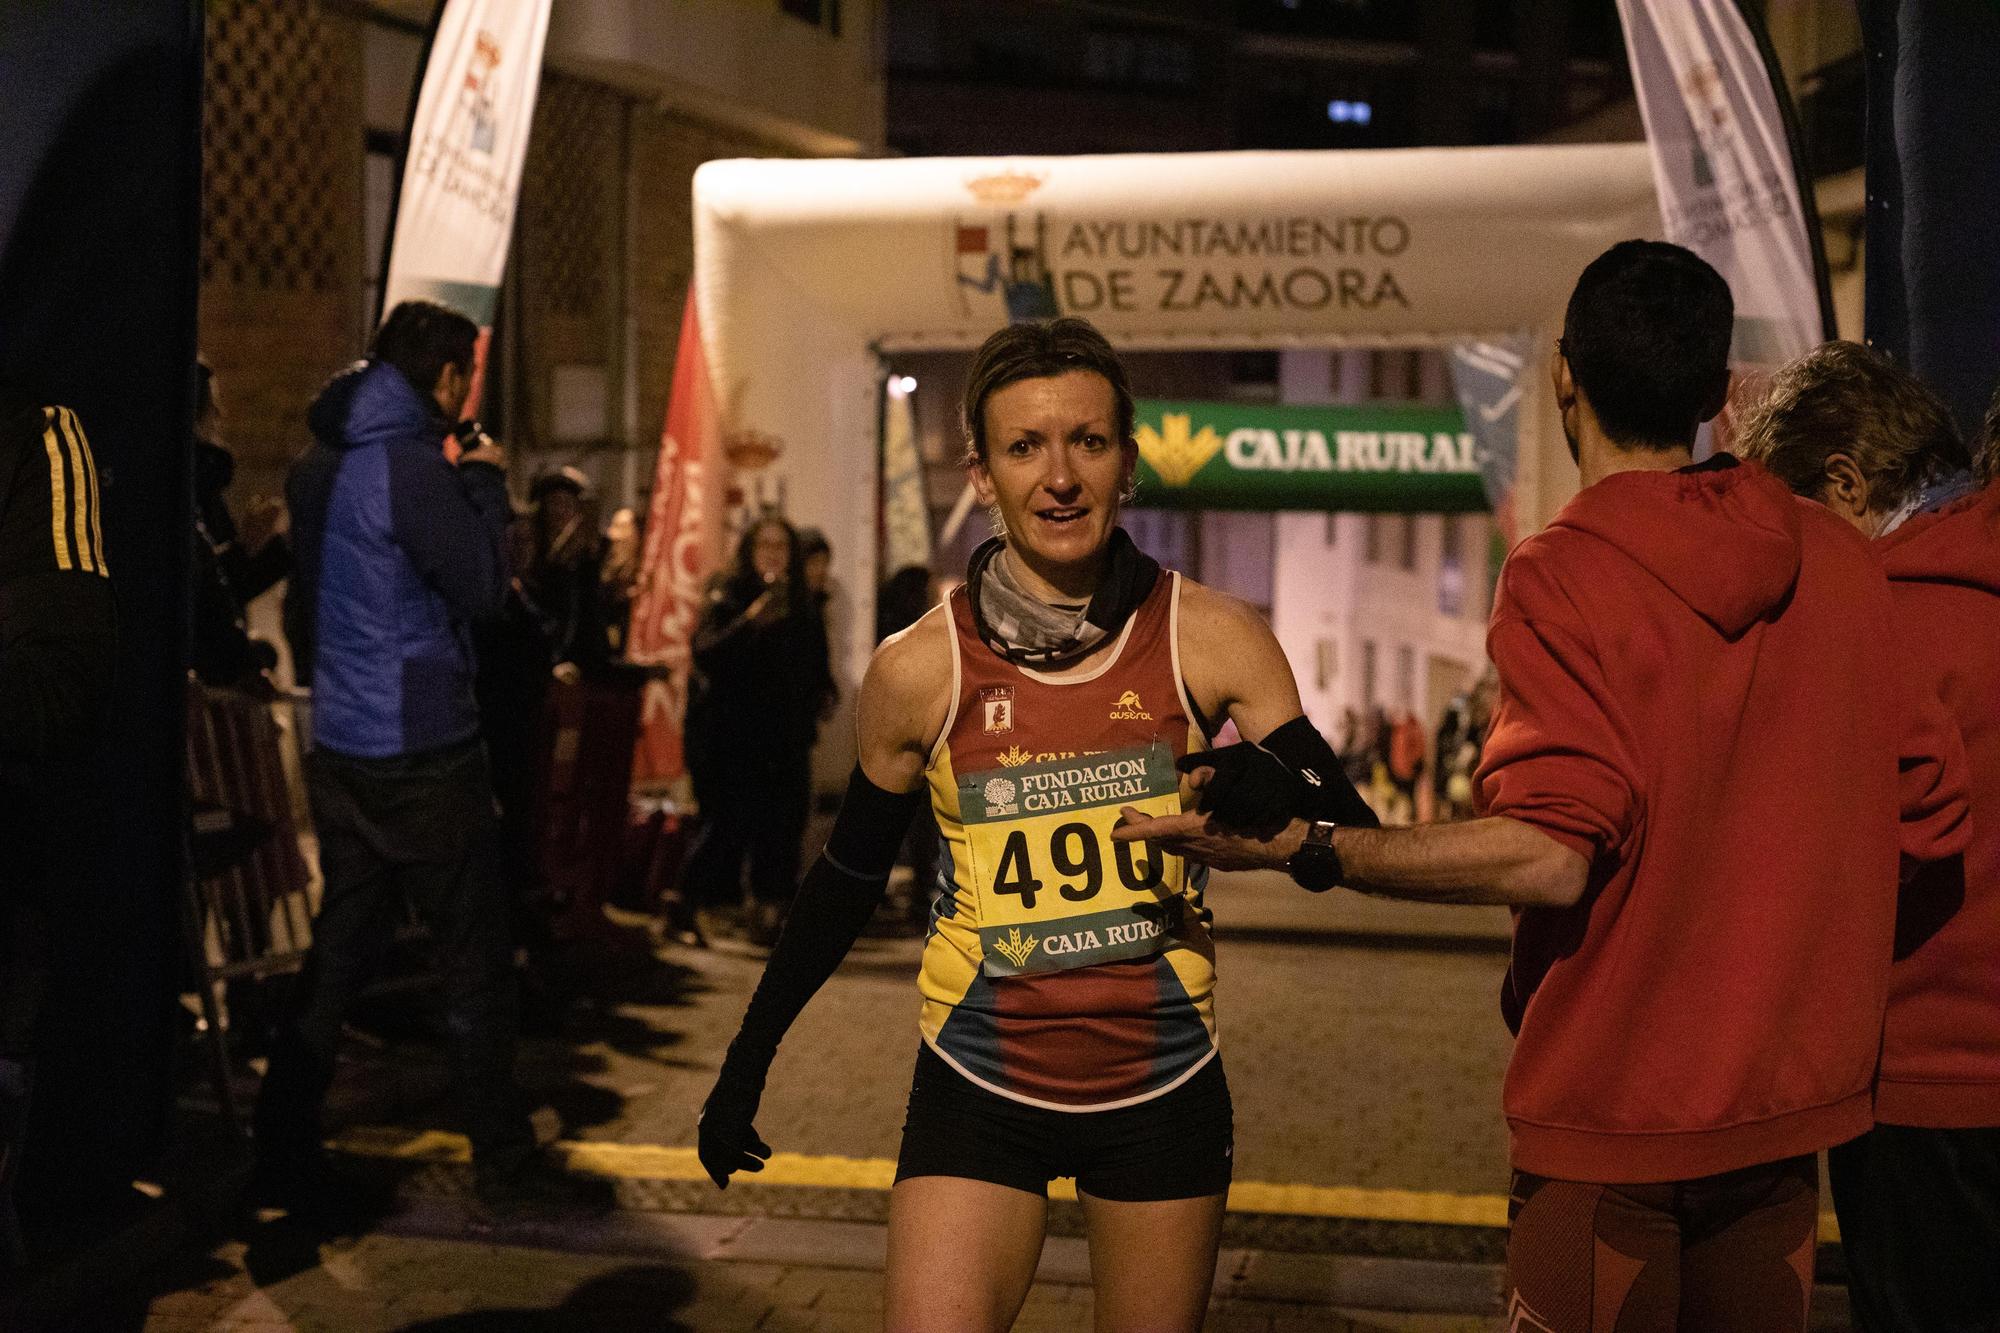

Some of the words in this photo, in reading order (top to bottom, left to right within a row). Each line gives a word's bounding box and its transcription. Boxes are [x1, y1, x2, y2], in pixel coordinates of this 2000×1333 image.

[1062, 216, 1411, 257] AYUNTAMIENTO
[1064, 270, 1136, 312] DE
[1157, 268, 1410, 310] ZAMORA
[1225, 428, 1330, 471] CAJA
[1334, 431, 1480, 474] RURAL
[1020, 758, 1147, 794] FUNDACION
[1024, 788, 1076, 811] CAJA
[1080, 779, 1150, 804] RURAL
[993, 814, 1166, 909] 490
[1042, 930, 1102, 955] CAJA
